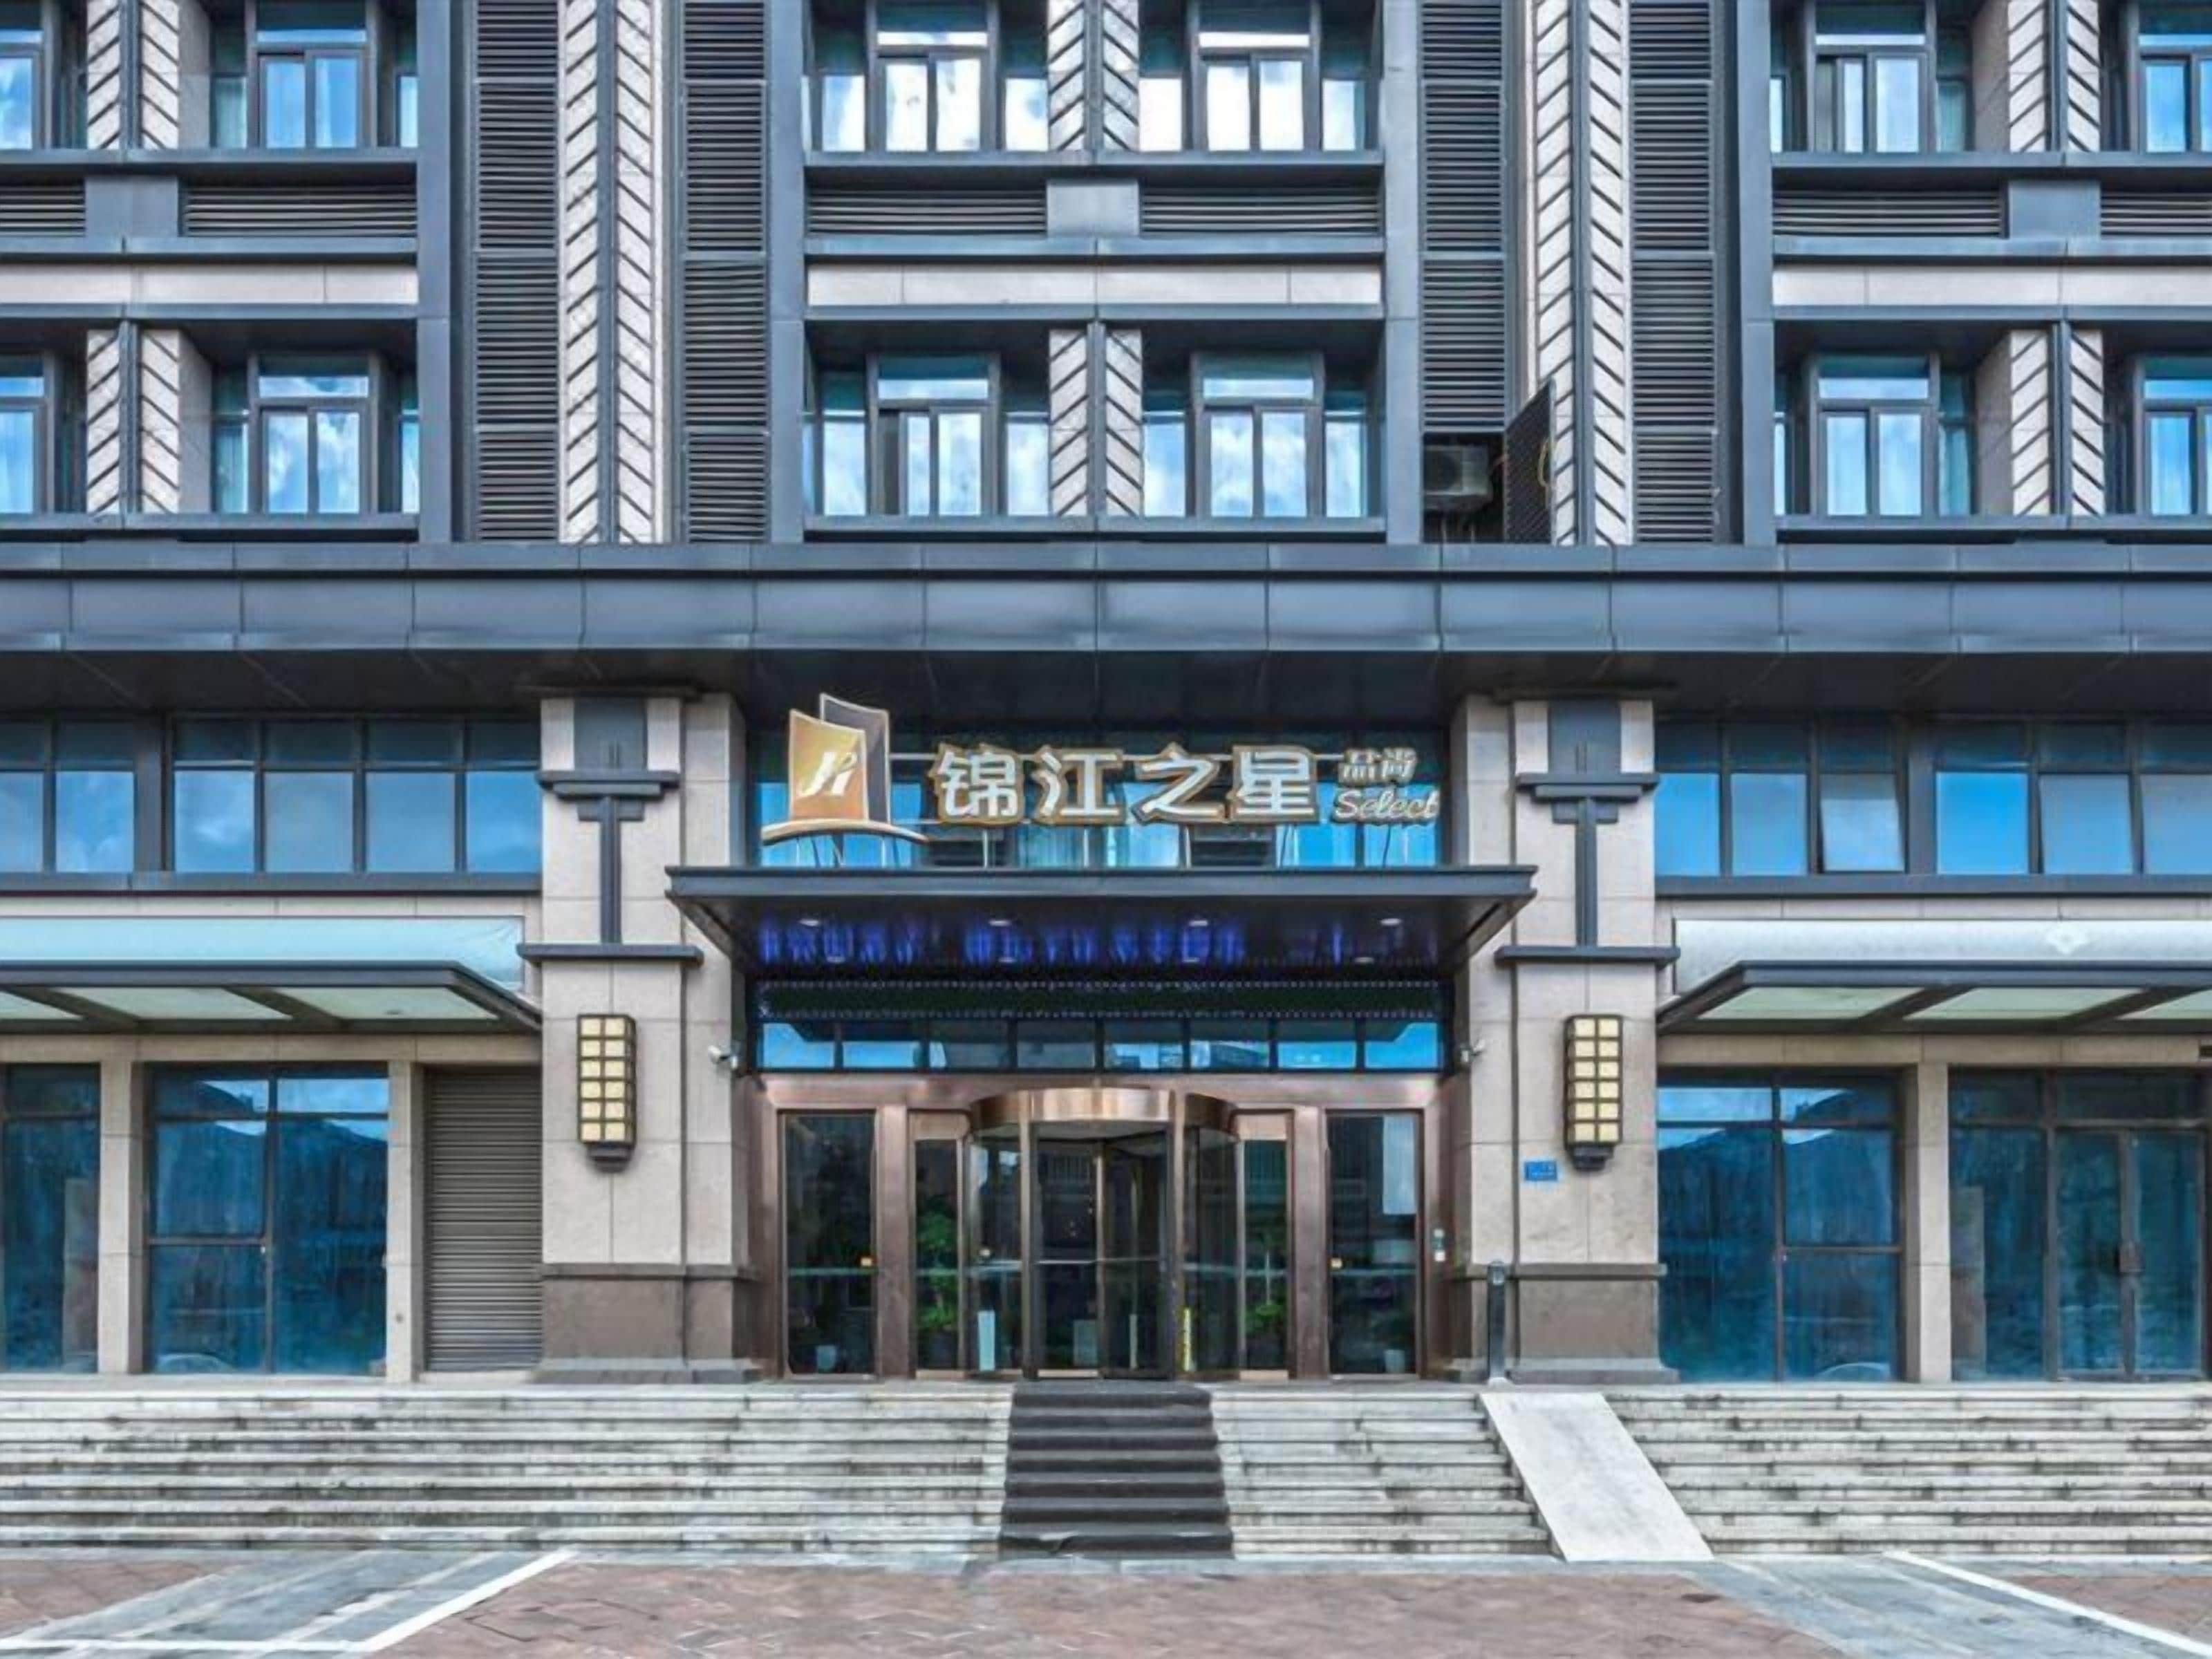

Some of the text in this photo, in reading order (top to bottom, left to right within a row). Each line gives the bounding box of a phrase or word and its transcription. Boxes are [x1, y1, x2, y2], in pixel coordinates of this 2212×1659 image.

[929, 742, 1318, 824] 锦江之星
[1333, 786, 1441, 823] Select
